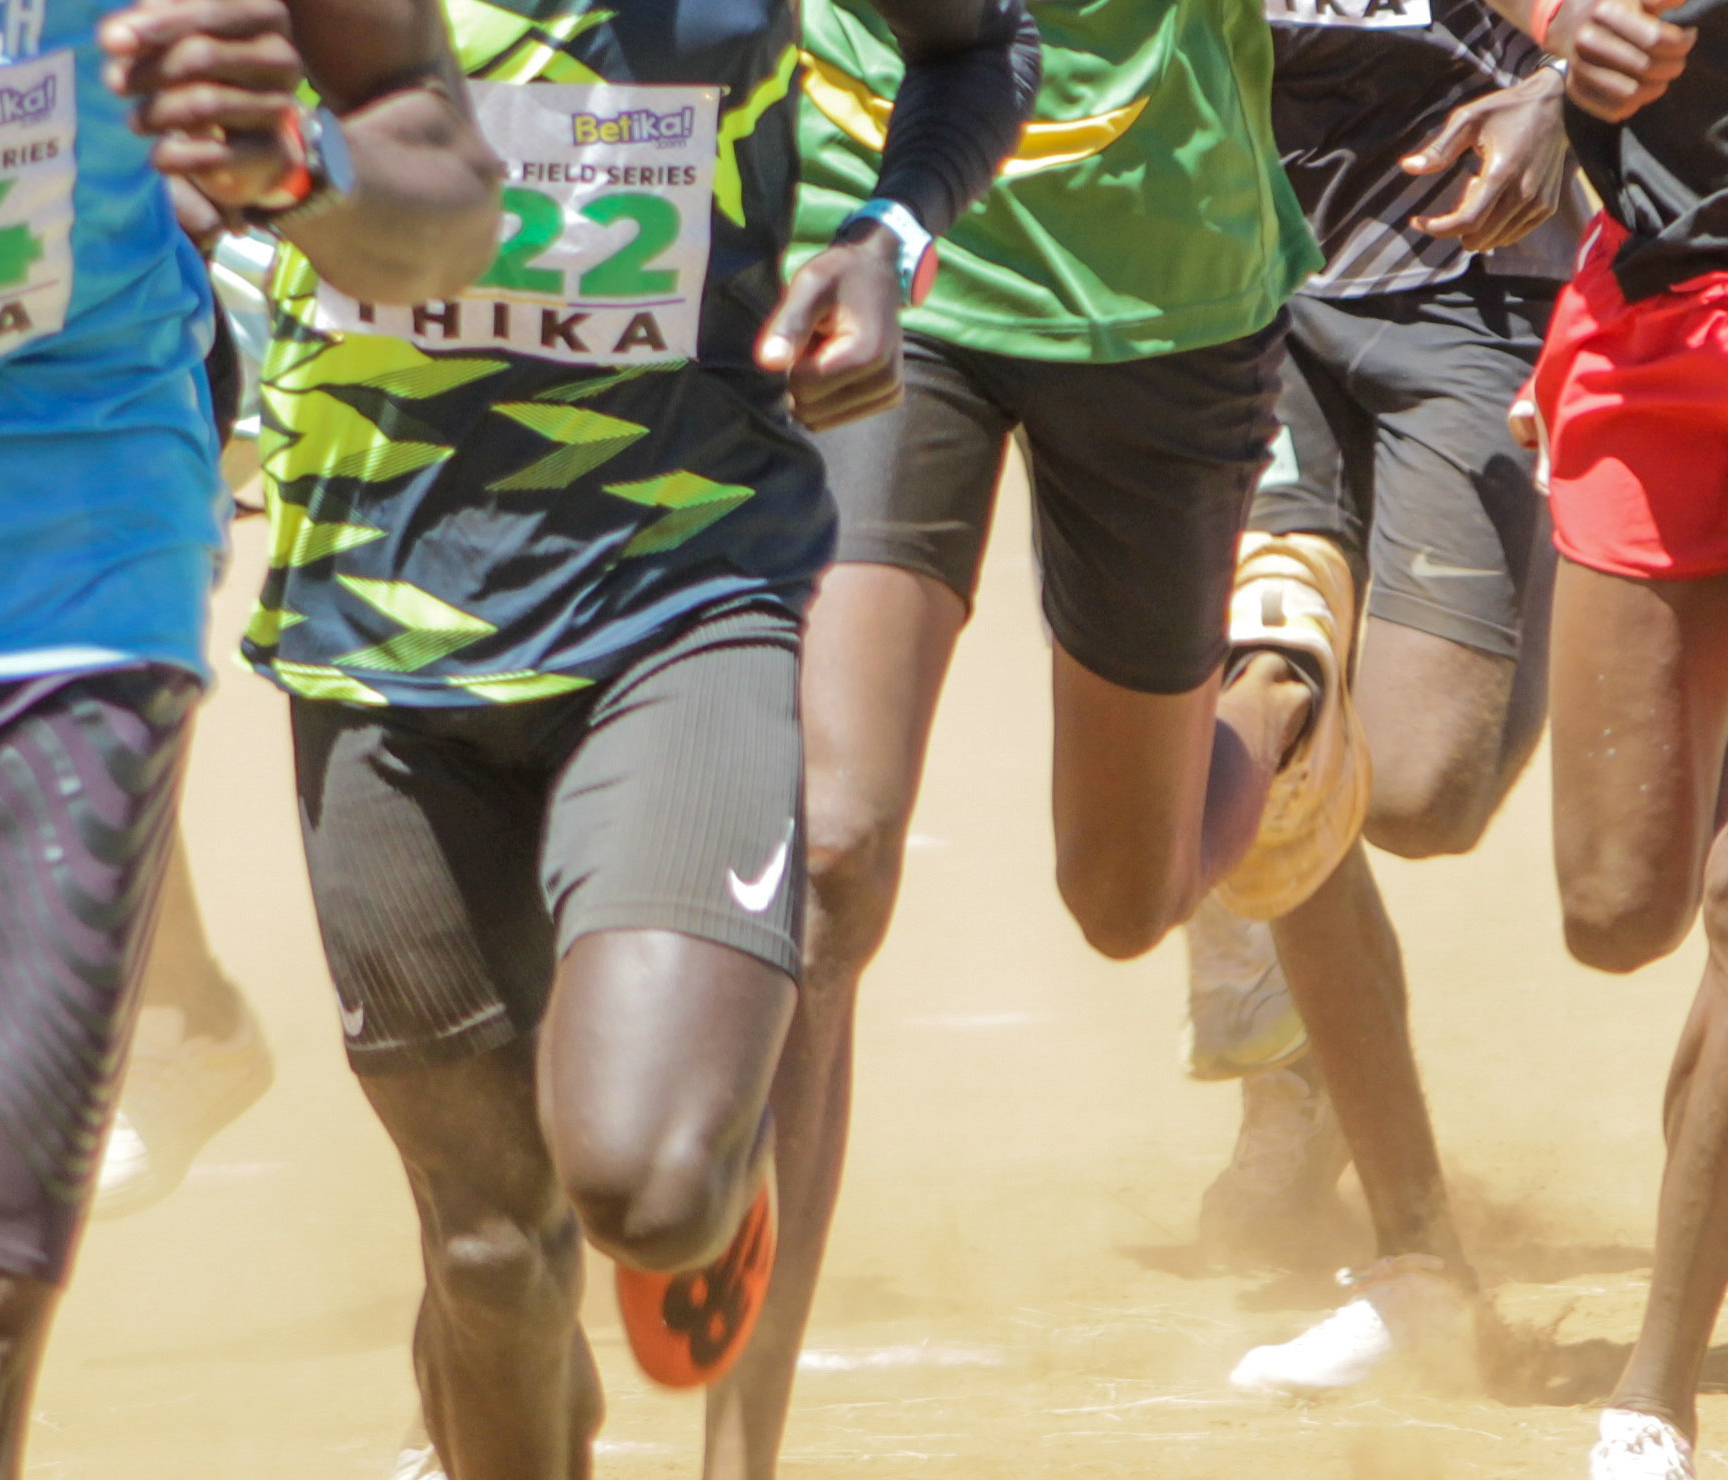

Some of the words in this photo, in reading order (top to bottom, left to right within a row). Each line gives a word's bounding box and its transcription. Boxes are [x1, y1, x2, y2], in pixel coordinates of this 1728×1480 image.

[572, 106, 695, 146] Betika!
[522, 161, 597, 184] FIELD
[606, 165, 698, 187] SERIES
[477, 187, 682, 297] 22
